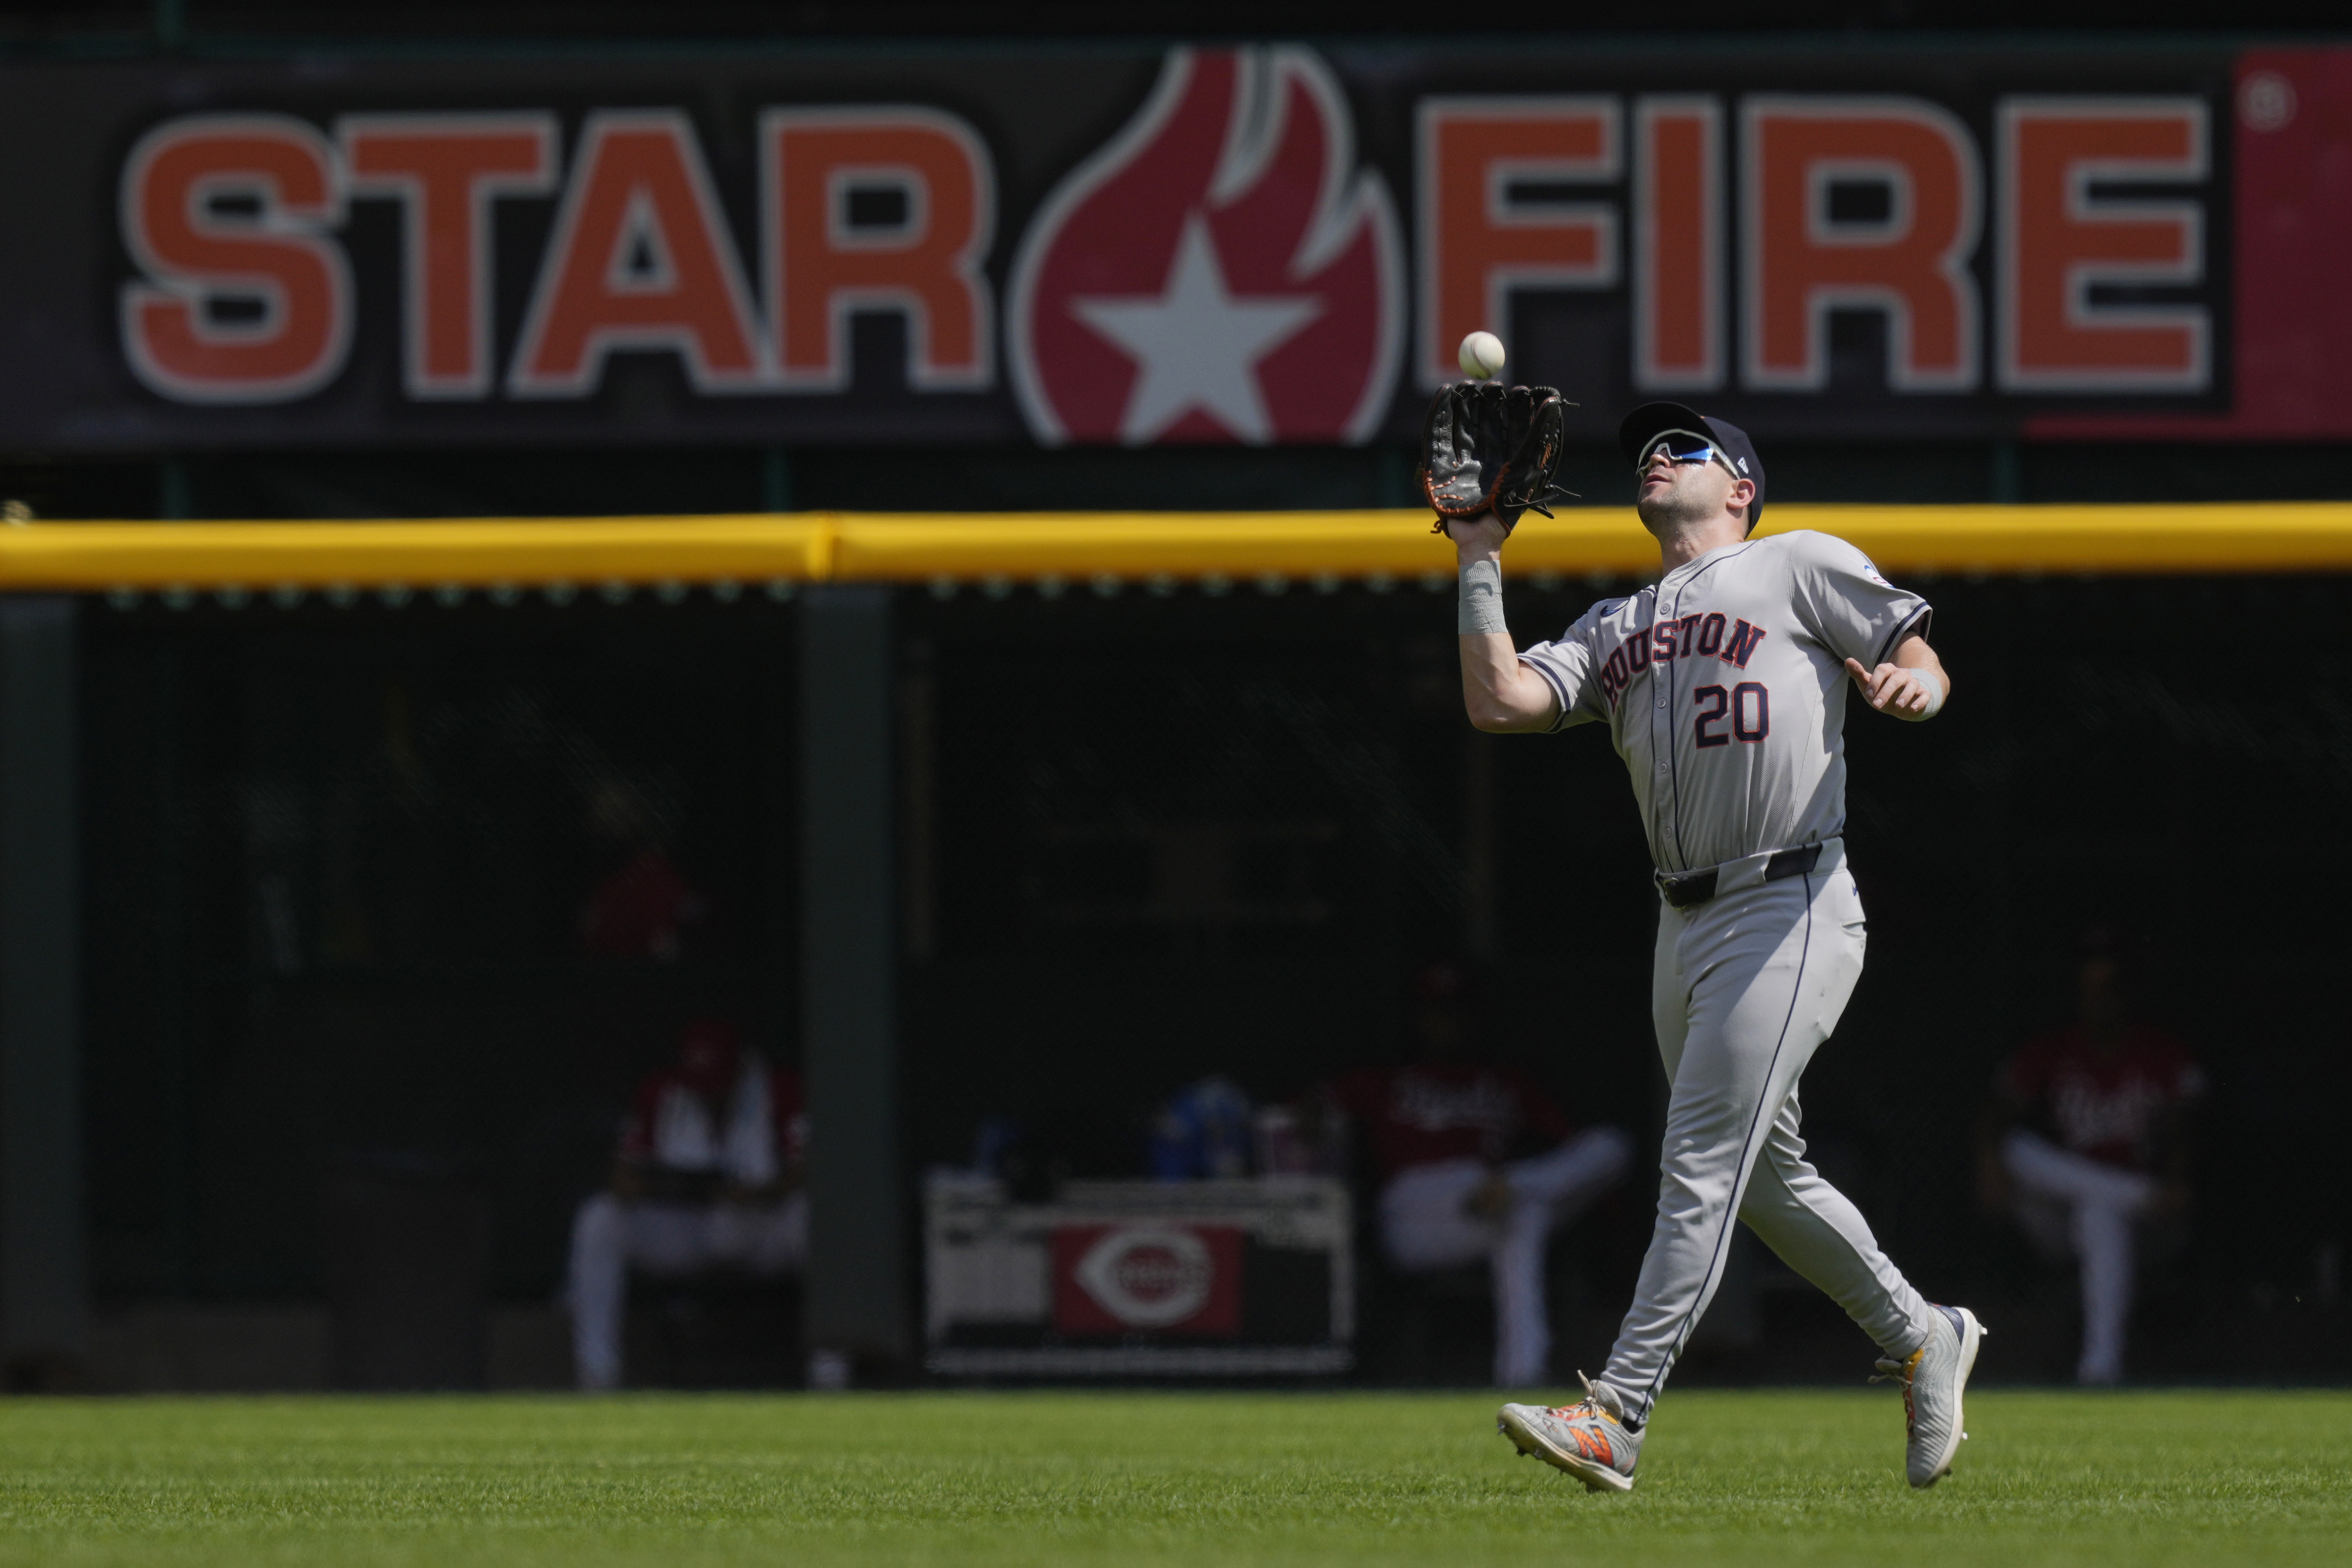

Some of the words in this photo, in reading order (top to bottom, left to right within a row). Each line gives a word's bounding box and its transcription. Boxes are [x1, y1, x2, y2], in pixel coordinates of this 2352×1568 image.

[120, 107, 998, 403] STAR
[1414, 95, 2211, 393] FIRE
[1601, 612, 1767, 715] HOUSTON
[1694, 681, 1770, 750] 20
